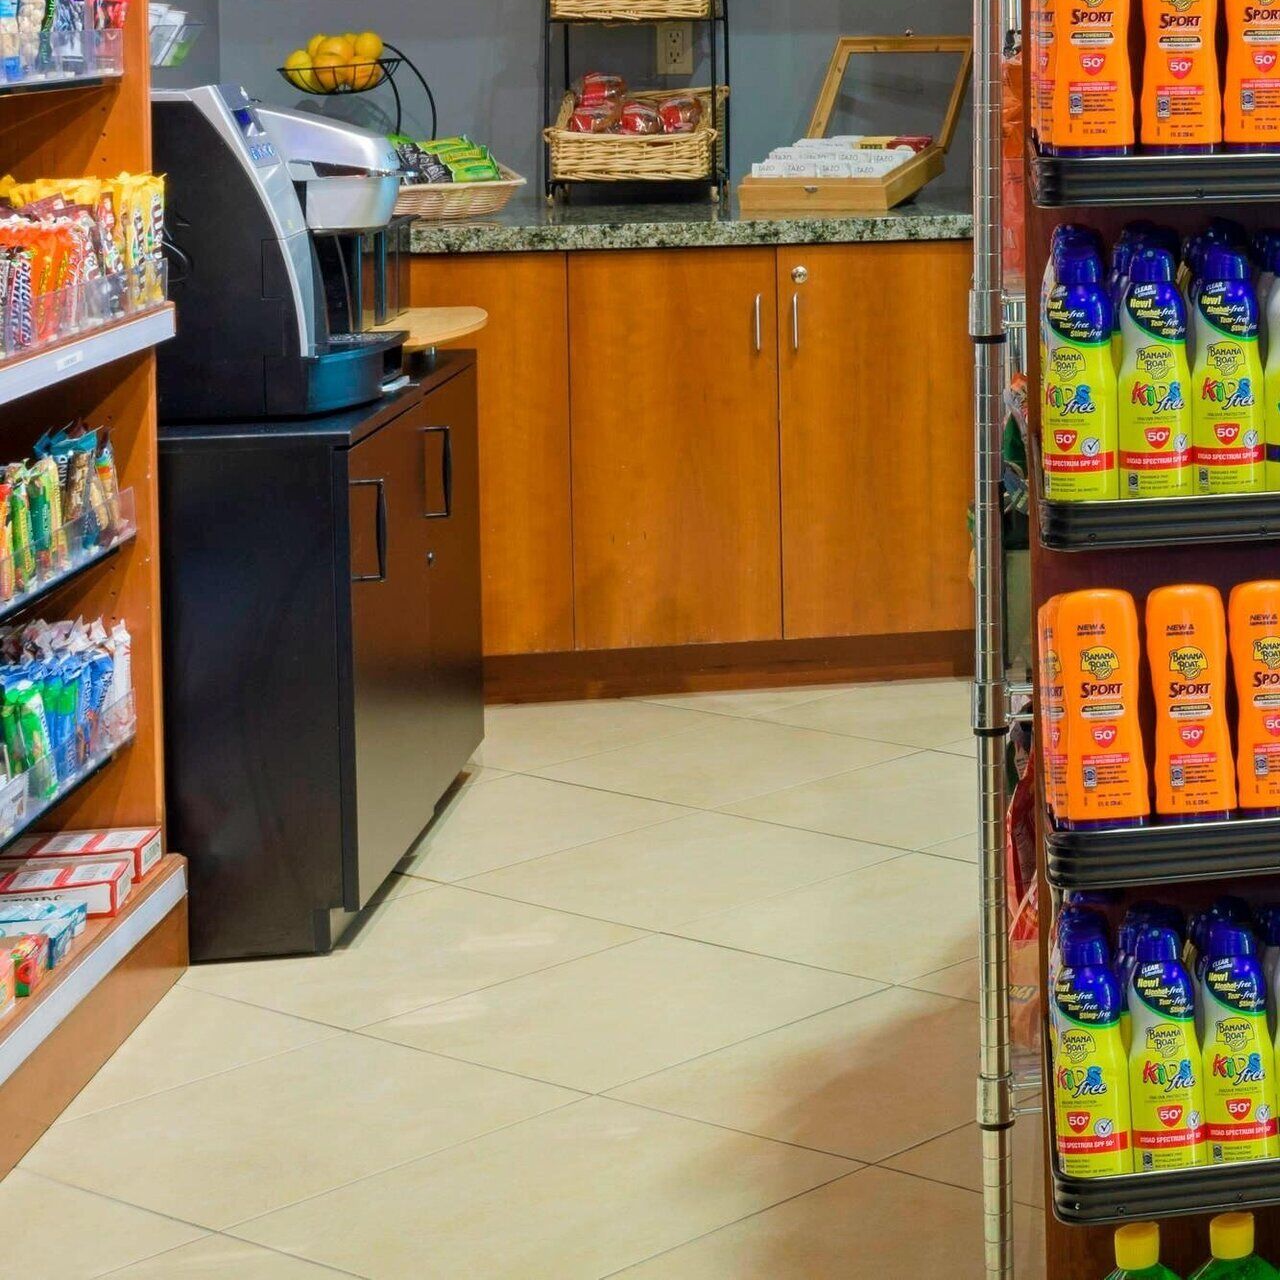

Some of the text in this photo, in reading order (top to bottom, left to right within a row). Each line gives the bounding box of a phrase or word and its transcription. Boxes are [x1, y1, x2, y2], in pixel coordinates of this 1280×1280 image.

[1071, 9, 1113, 24] SPORT
[1159, 14, 1201, 29] SPORT
[1156, 394, 1184, 416] free
[59, 455, 69, 486] KIND
[1080, 682, 1122, 698] SPORT
[1169, 682, 1211, 698] SPORT
